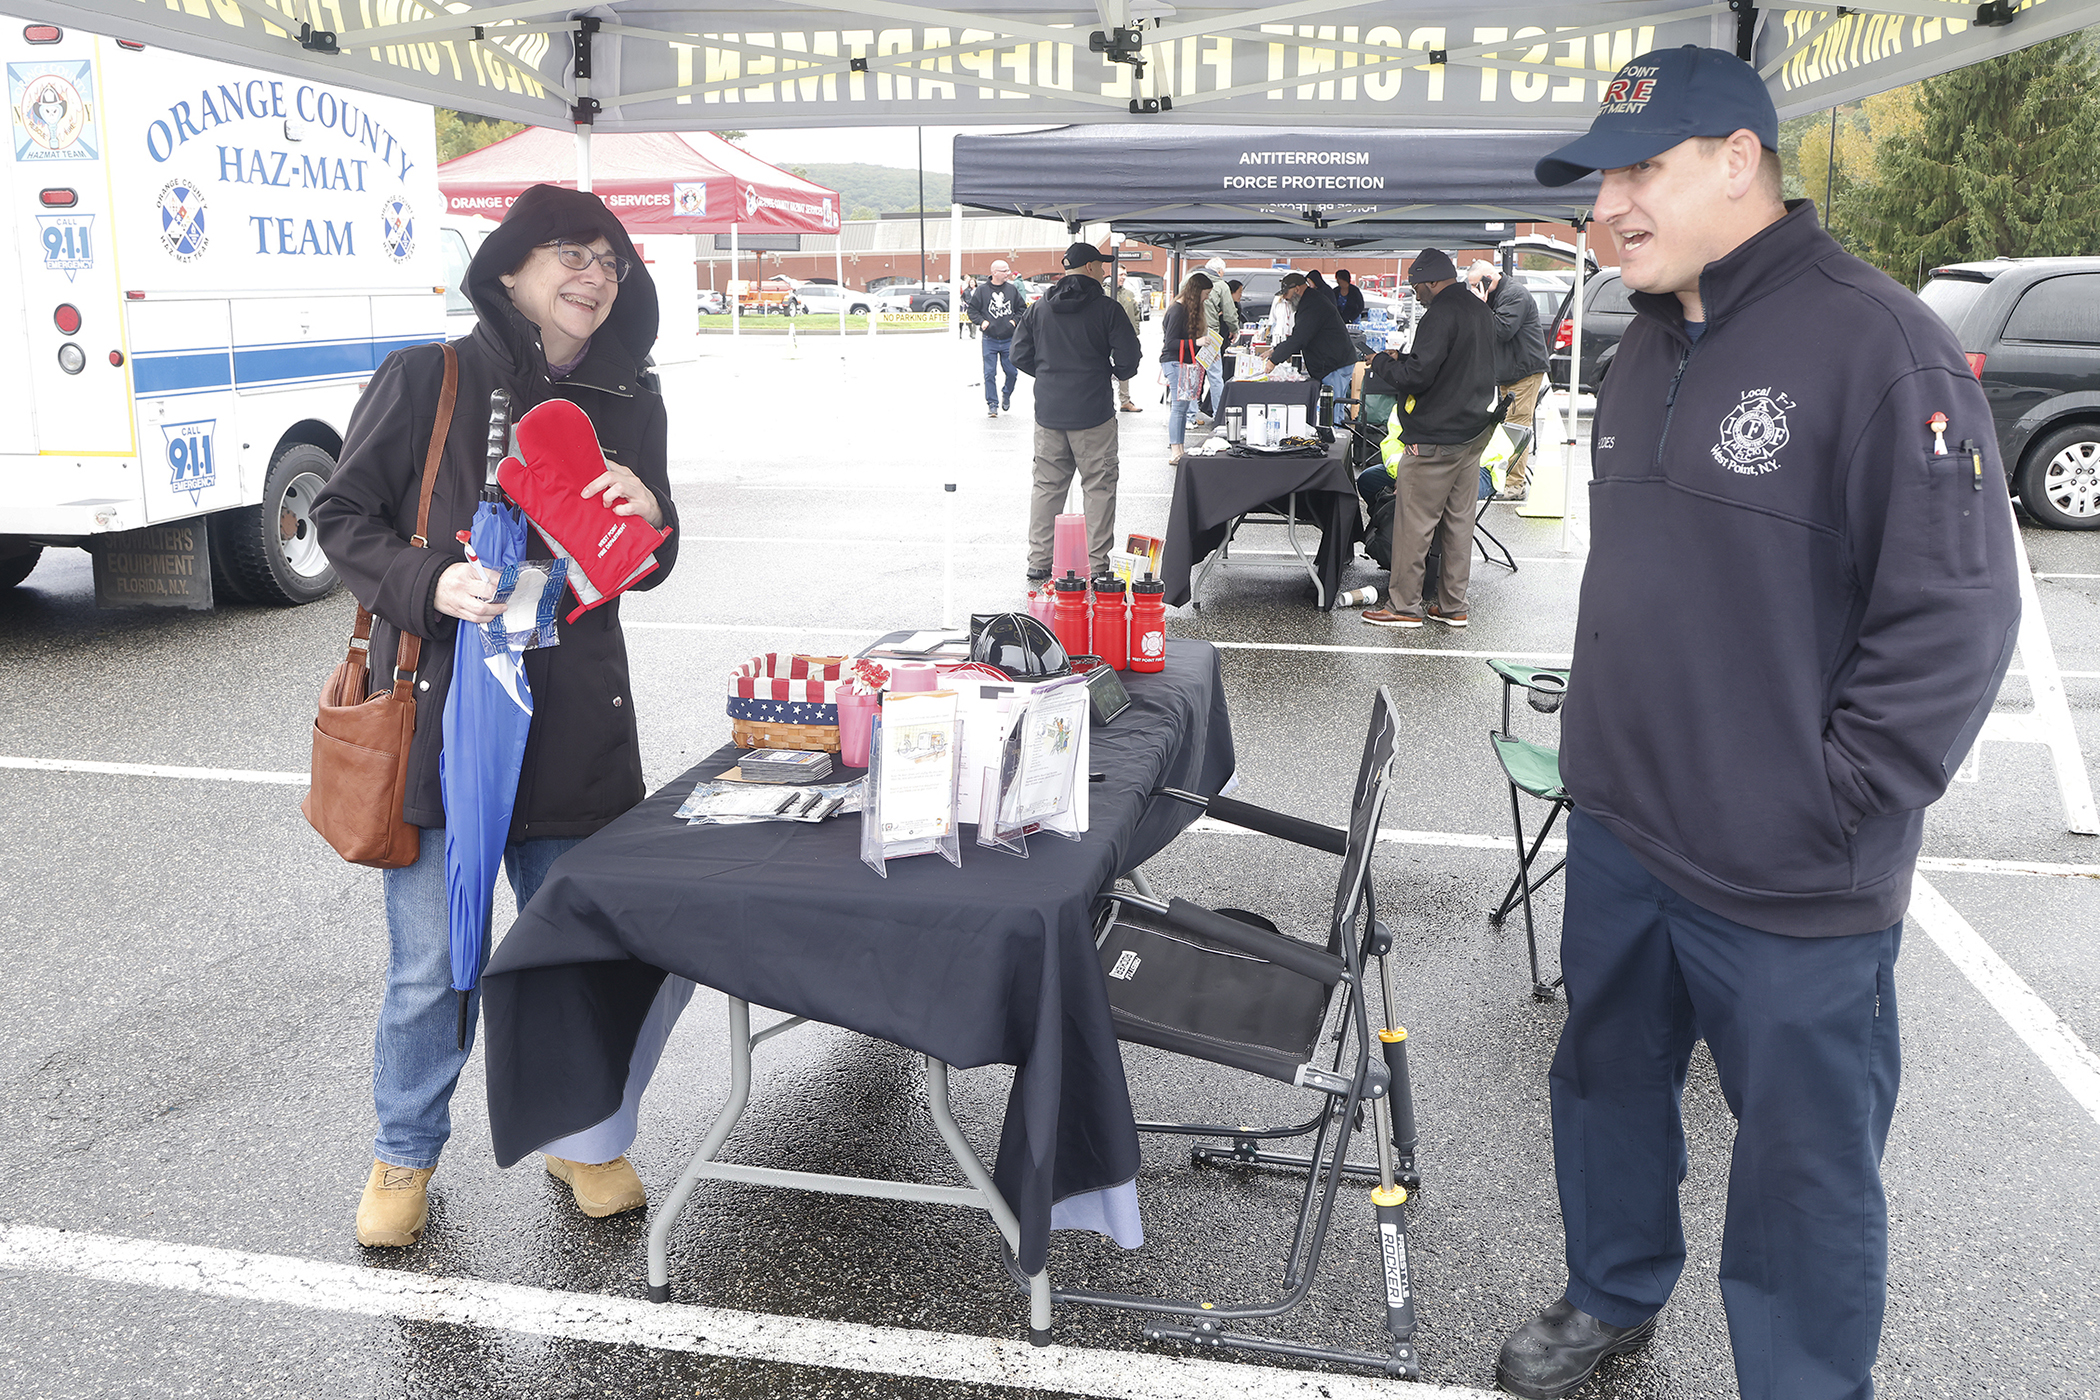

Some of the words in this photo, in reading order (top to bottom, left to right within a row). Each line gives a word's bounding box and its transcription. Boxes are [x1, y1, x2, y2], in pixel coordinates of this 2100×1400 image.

[1619, 65, 1660, 77] POINT
[147, 79, 287, 163] ORANGE
[296, 85, 414, 185] COUNTY
[27, 151, 60, 159] HAZMAT
[63, 150, 87, 158] TEAM
[1239, 152, 1370, 165] ANTITERRORISM
[216, 145, 368, 192] HAZ-MAT
[1223, 176, 1278, 189] FORCE
[1281, 176, 1385, 189] PROTECTION
[156, 178, 179, 209] ORANGE
[182, 178, 208, 209] COUNTY
[451, 196, 503, 209] ORANGE
[609, 194, 671, 206] SERVICES
[56, 218, 78, 226] CALL
[249, 215, 356, 256] TEAM
[883, 314, 894, 322] NO
[895, 313, 927, 322] PARKING
[1741, 386, 1772, 401] Local
[1775, 392, 1797, 410] F-7
[181, 426, 201, 436] CALL
[1710, 443, 1728, 467] West
[1727, 459, 1758, 476] Point,
[172, 475, 216, 491] EMERGENCY
[597, 534, 609, 547] WEST
[607, 523, 618, 537] POINT
[597, 547, 608, 559] FIRE
[605, 522, 627, 549] DEPARTMENT
[106, 553, 195, 576] EQUIPMENT
[117, 578, 168, 596] FLORIDA,
[168, 580, 190, 595] N.Y.
[1384, 1233, 1400, 1299] ROCKER
[1397, 1234, 1410, 1299] FREESTYLE
